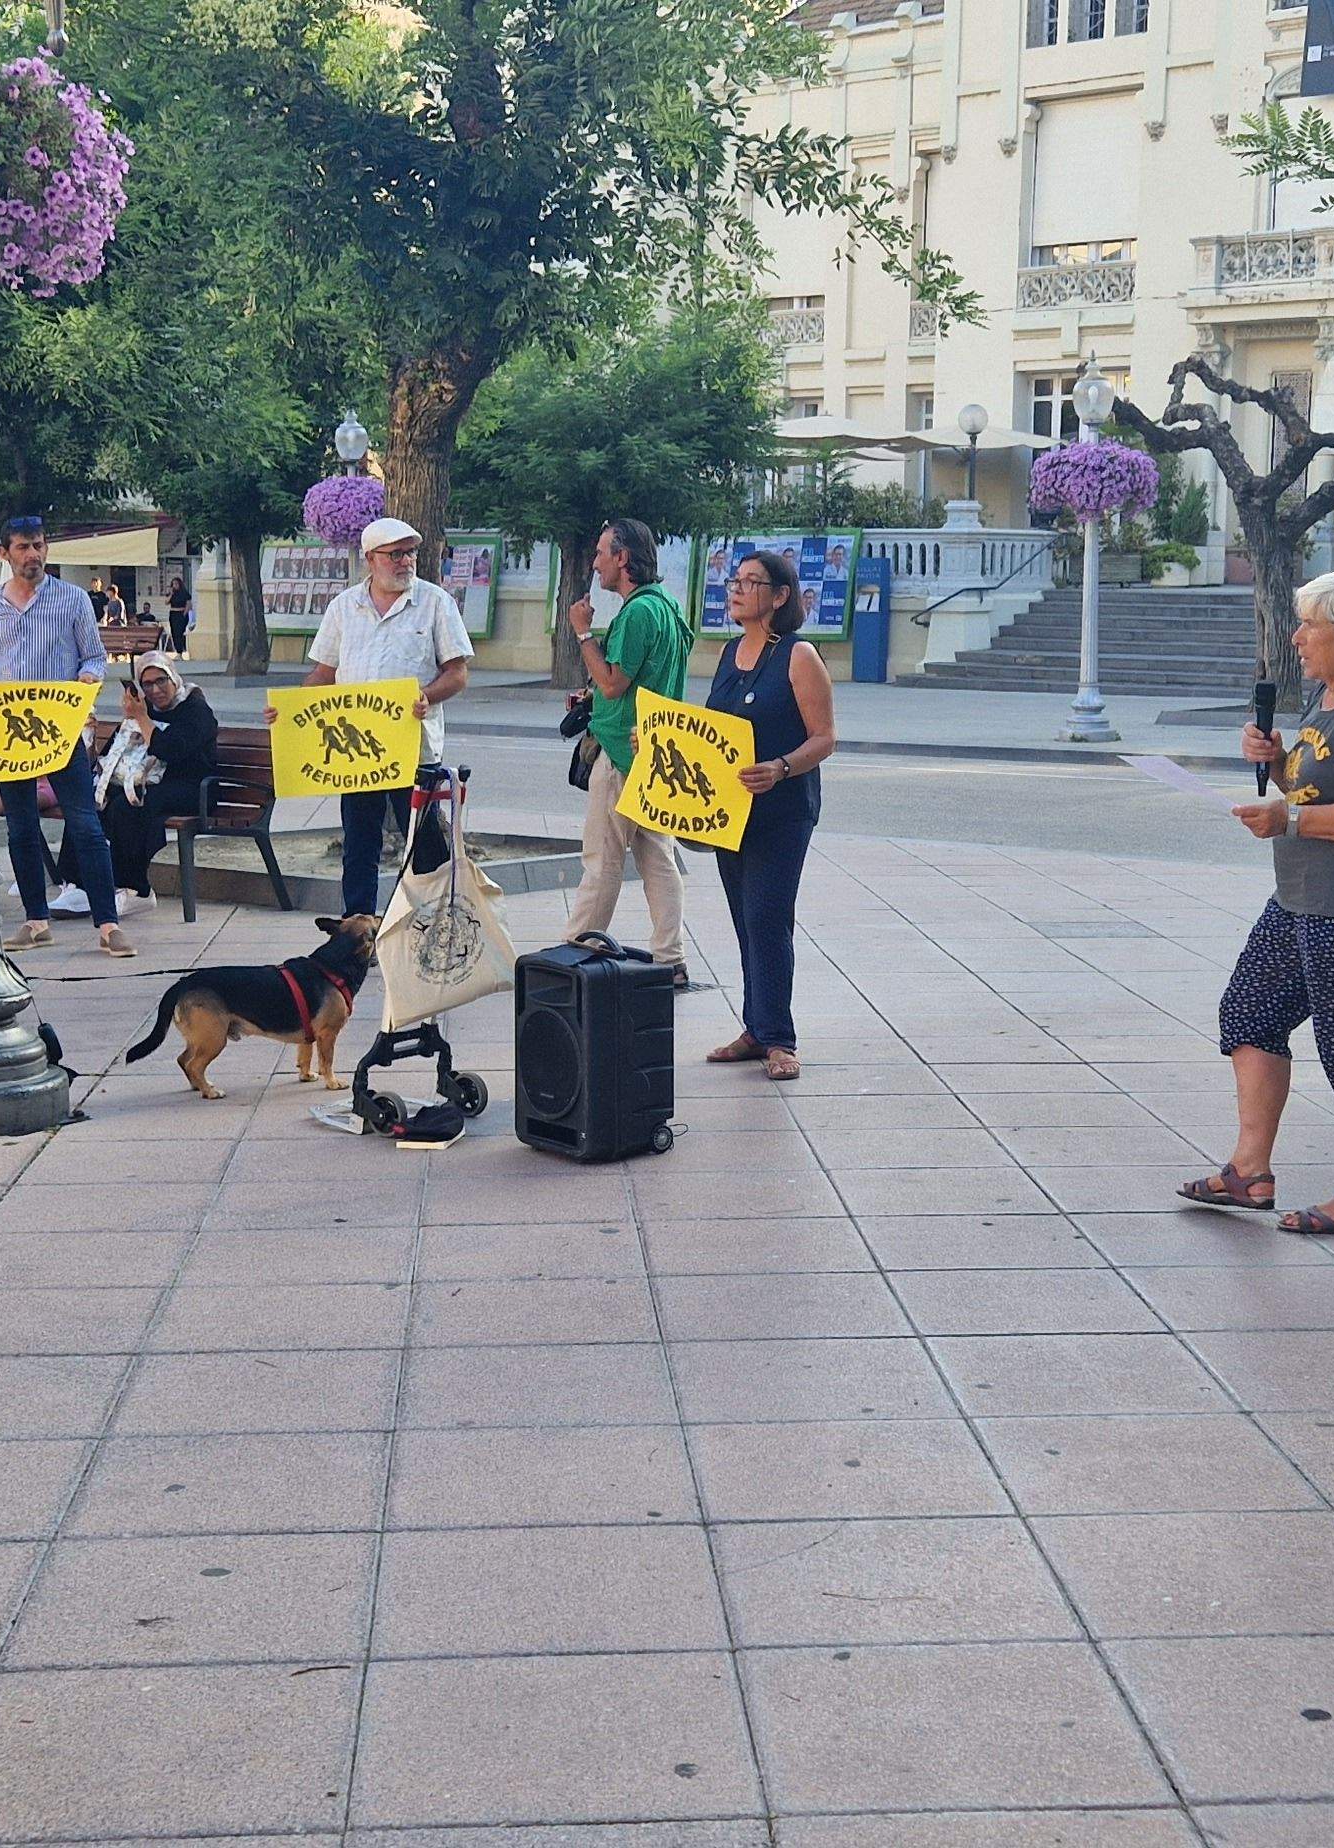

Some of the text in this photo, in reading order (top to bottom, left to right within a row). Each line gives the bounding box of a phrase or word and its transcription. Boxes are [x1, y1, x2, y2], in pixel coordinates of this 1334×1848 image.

[293, 693, 404, 728] BIENVENIDXS
[642, 710, 740, 764] BIENVENIDXS
[300, 761, 401, 788] REFUGIADXS
[638, 781, 729, 833] REFUGIADXS
